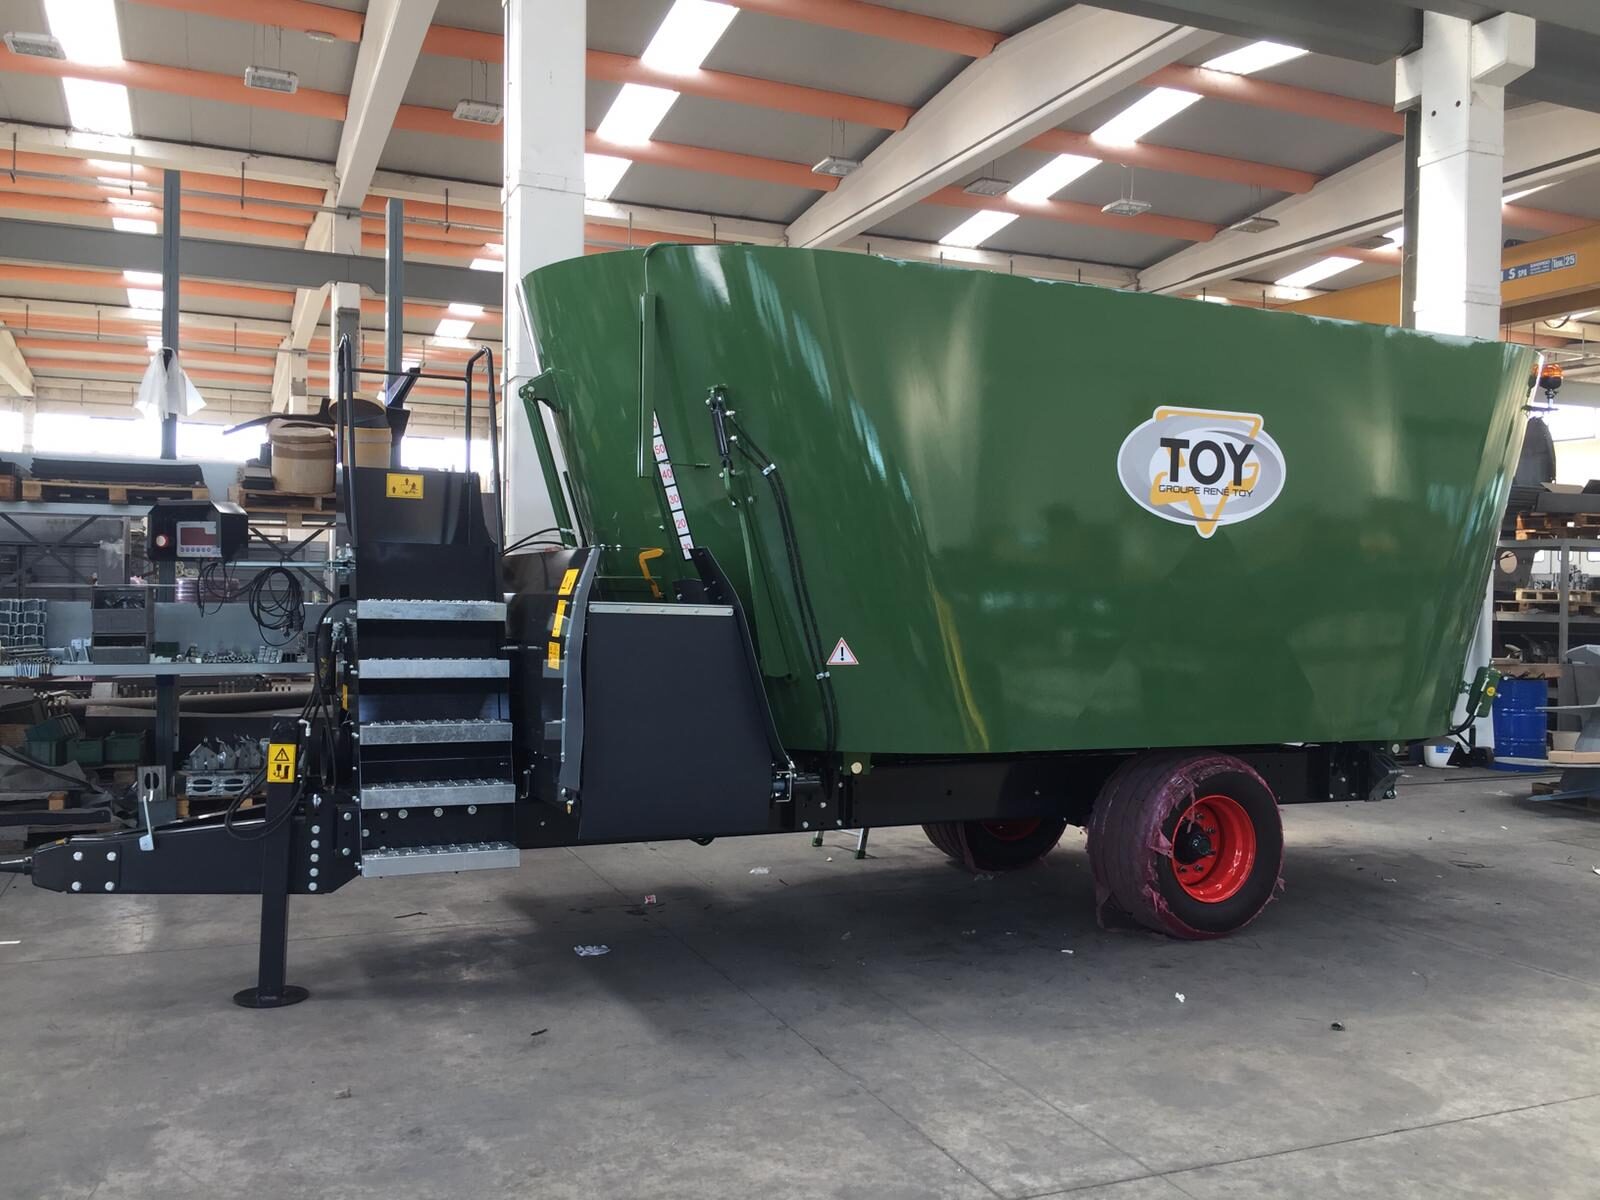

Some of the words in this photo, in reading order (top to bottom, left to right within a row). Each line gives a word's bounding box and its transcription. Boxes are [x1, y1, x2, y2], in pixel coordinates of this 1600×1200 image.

[1564, 255, 1575, 265] 25
[655, 444, 666, 454] 50
[1160, 437, 1254, 486] TOY
[662, 469, 673, 479] 40
[1158, 485, 1201, 495] GROUPE
[1203, 487, 1230, 496] RENÉ
[1232, 489, 1254, 498] TOY
[669, 495, 679, 505] 30
[676, 518, 687, 529] 20
